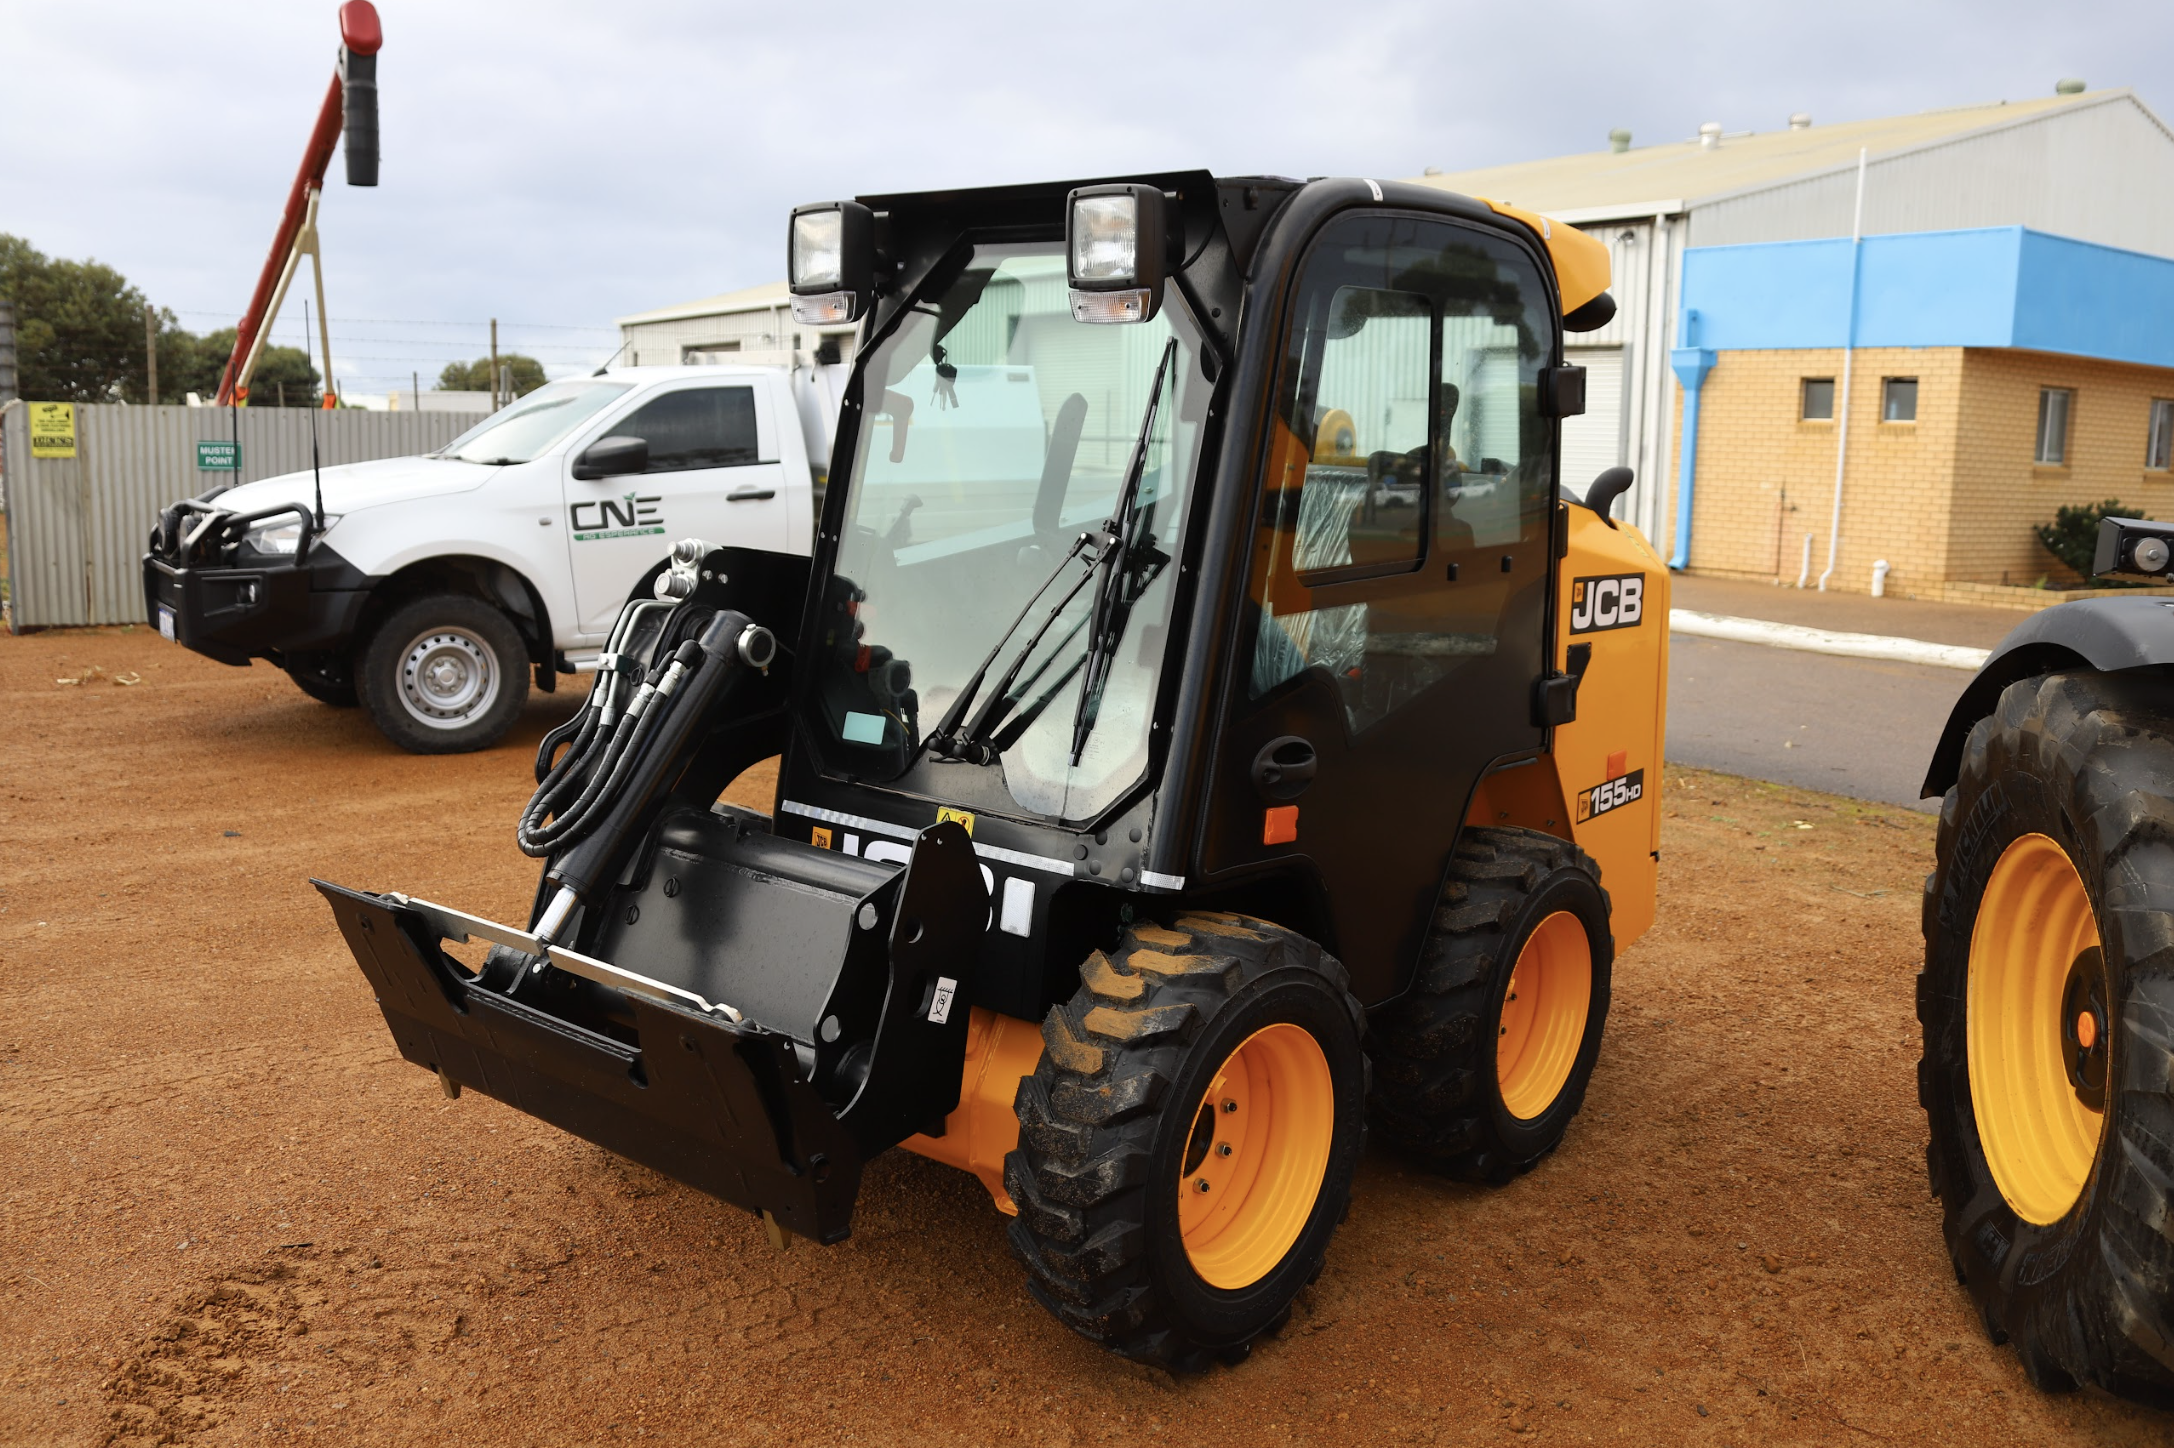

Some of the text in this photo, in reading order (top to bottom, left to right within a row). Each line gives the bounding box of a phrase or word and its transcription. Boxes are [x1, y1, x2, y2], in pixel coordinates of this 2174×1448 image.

[205, 456, 233, 465] POINT
[570, 496, 664, 530] CNE
[583, 528, 655, 540] AG ESPERANCE
[1572, 577, 1643, 630] JCB
